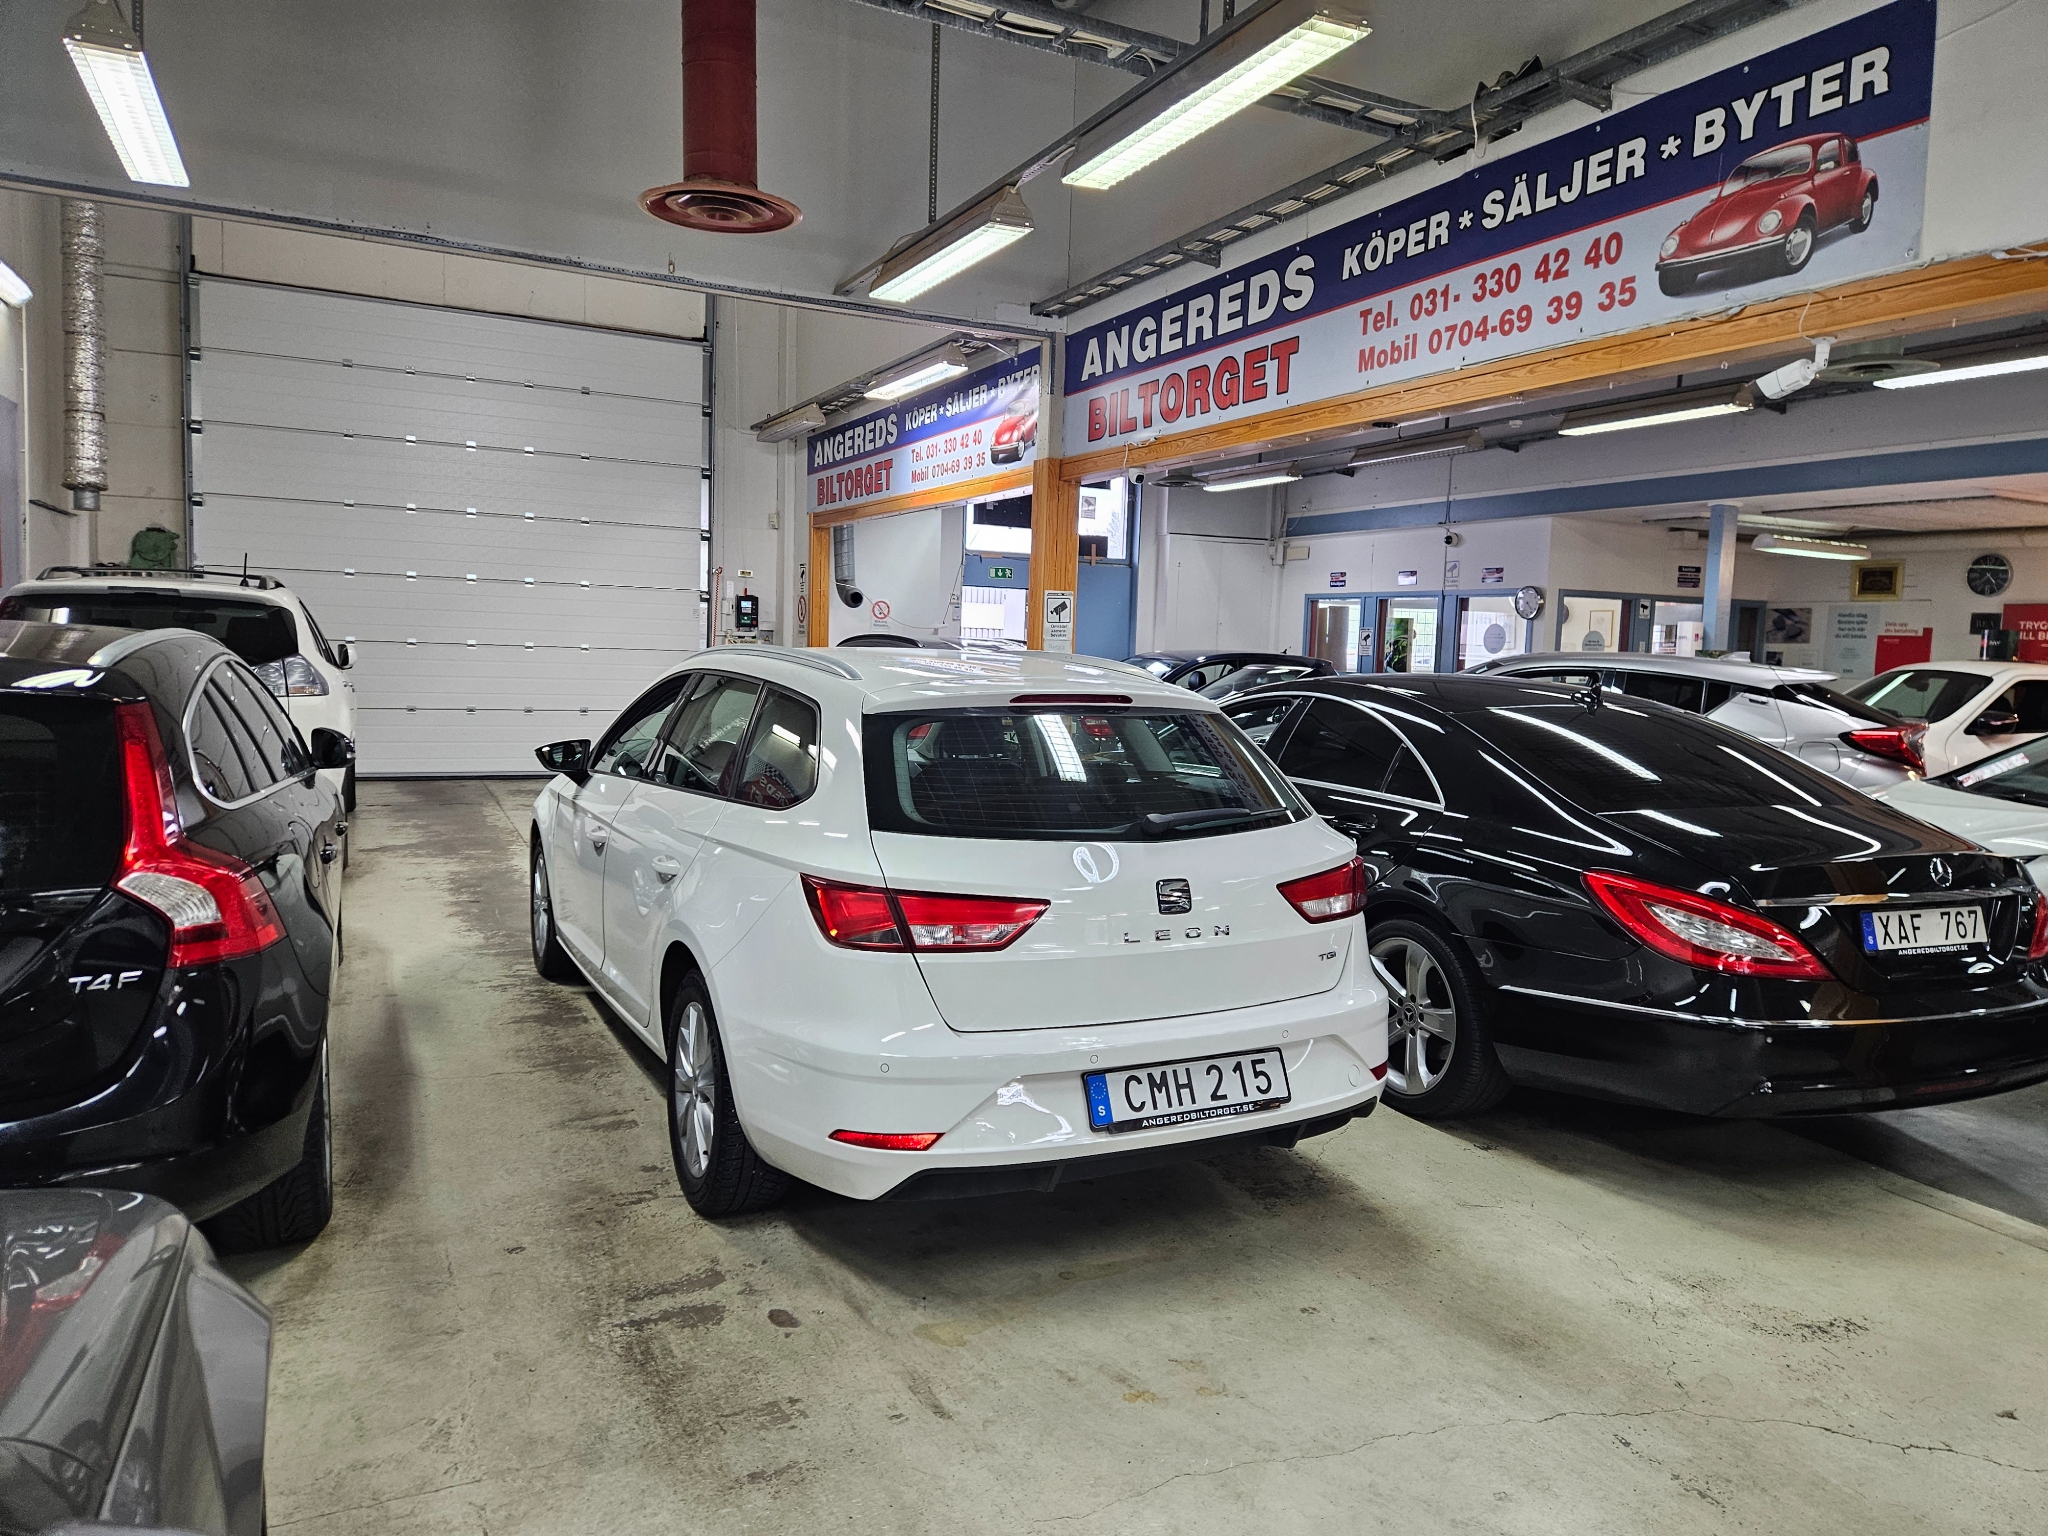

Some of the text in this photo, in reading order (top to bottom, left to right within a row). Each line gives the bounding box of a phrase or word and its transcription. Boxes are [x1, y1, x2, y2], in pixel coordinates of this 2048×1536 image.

[1341, 45, 1890, 281] KÖPER SÄLJER BYTER
[1358, 231, 1623, 336] Tel. 031- 330 42 40
[1081, 254, 1315, 382] ANGEREDS
[1357, 275, 1638, 373] Mobil 0704-69 39 35
[905, 364, 1041, 431] KÖPER SÄLJER BYTER
[1087, 335, 1300, 442] BILTORGET
[814, 413, 898, 468] ANGEREDS
[911, 446, 924, 464] Tel.
[943, 437, 957, 454] 330
[960, 432, 970, 449] 42
[973, 429, 983, 446] 40
[816, 458, 893, 506] BILTORGET
[911, 452, 986, 483] Mobil 0704-69 39 35
[1123, 924, 1231, 943] LEON
[1877, 909, 1978, 946] XAF 767
[1318, 950, 1337, 962] TGI
[68, 970, 143, 994] T4F
[1123, 1057, 1272, 1114] CMH 215
[1097, 1105, 1106, 1117] S
[1141, 1103, 1255, 1128] ANGEREDBILTORGET.SE
